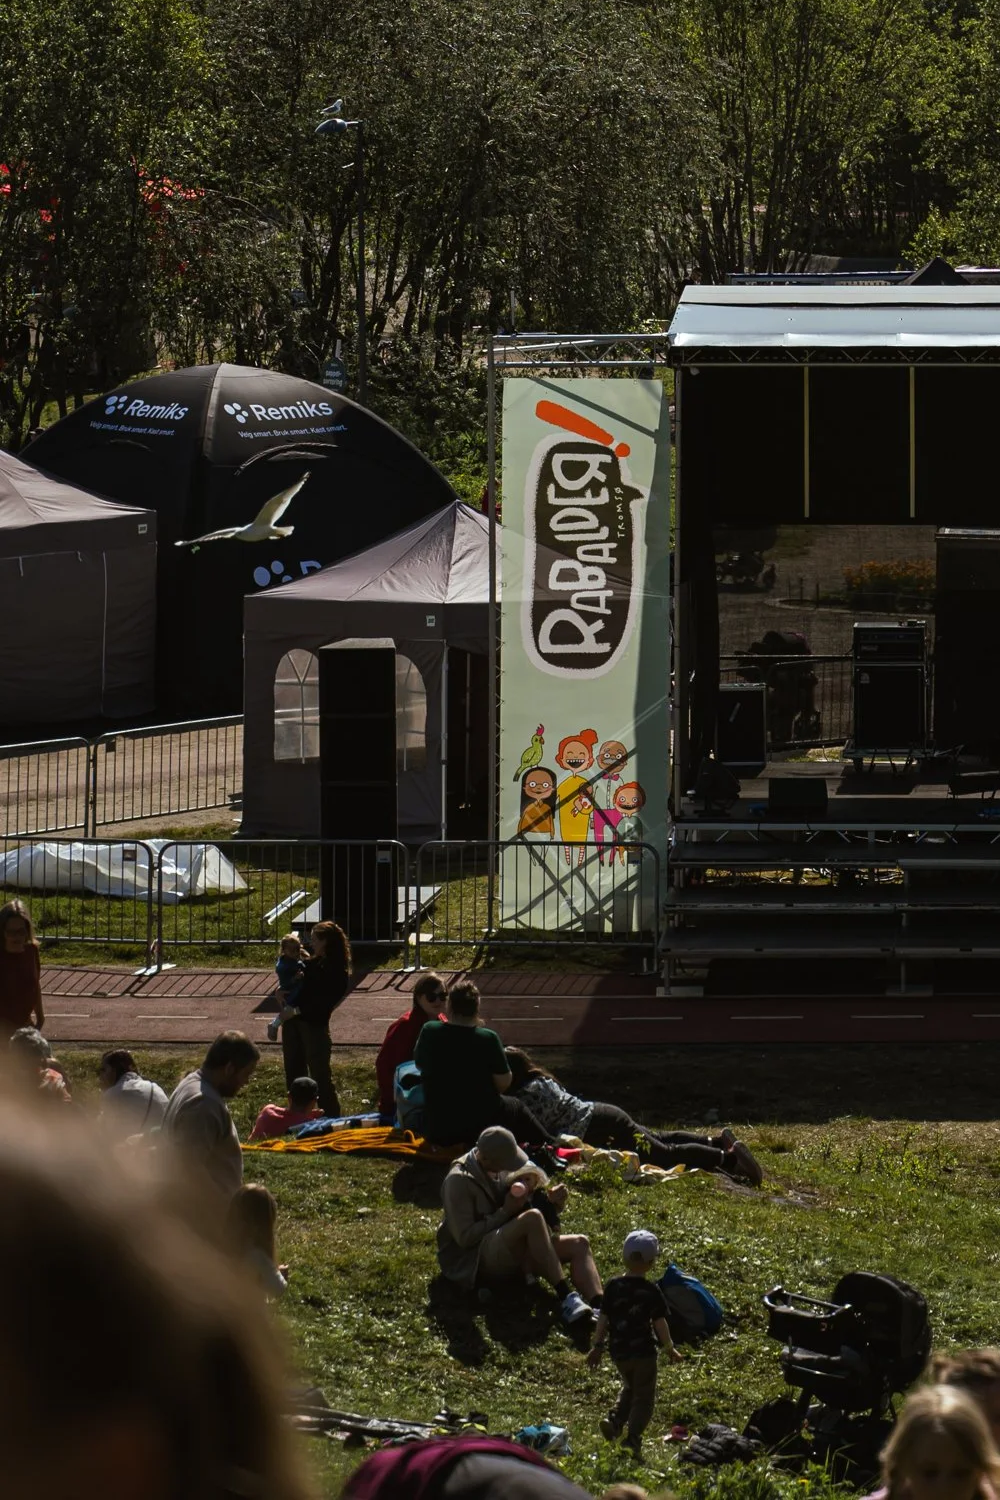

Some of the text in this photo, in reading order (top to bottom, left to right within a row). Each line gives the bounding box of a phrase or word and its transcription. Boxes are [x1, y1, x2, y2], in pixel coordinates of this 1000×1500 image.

[124, 398, 189, 421] Remiks
[249, 399, 334, 422] Remiks
[238, 431, 254, 440] Velg
[254, 430, 274, 438] smart.
[273, 429, 290, 437] Bruk
[290, 428, 311, 436] smart.
[310, 426, 327, 434] Kast
[613, 485, 627, 539] TROMSØ
